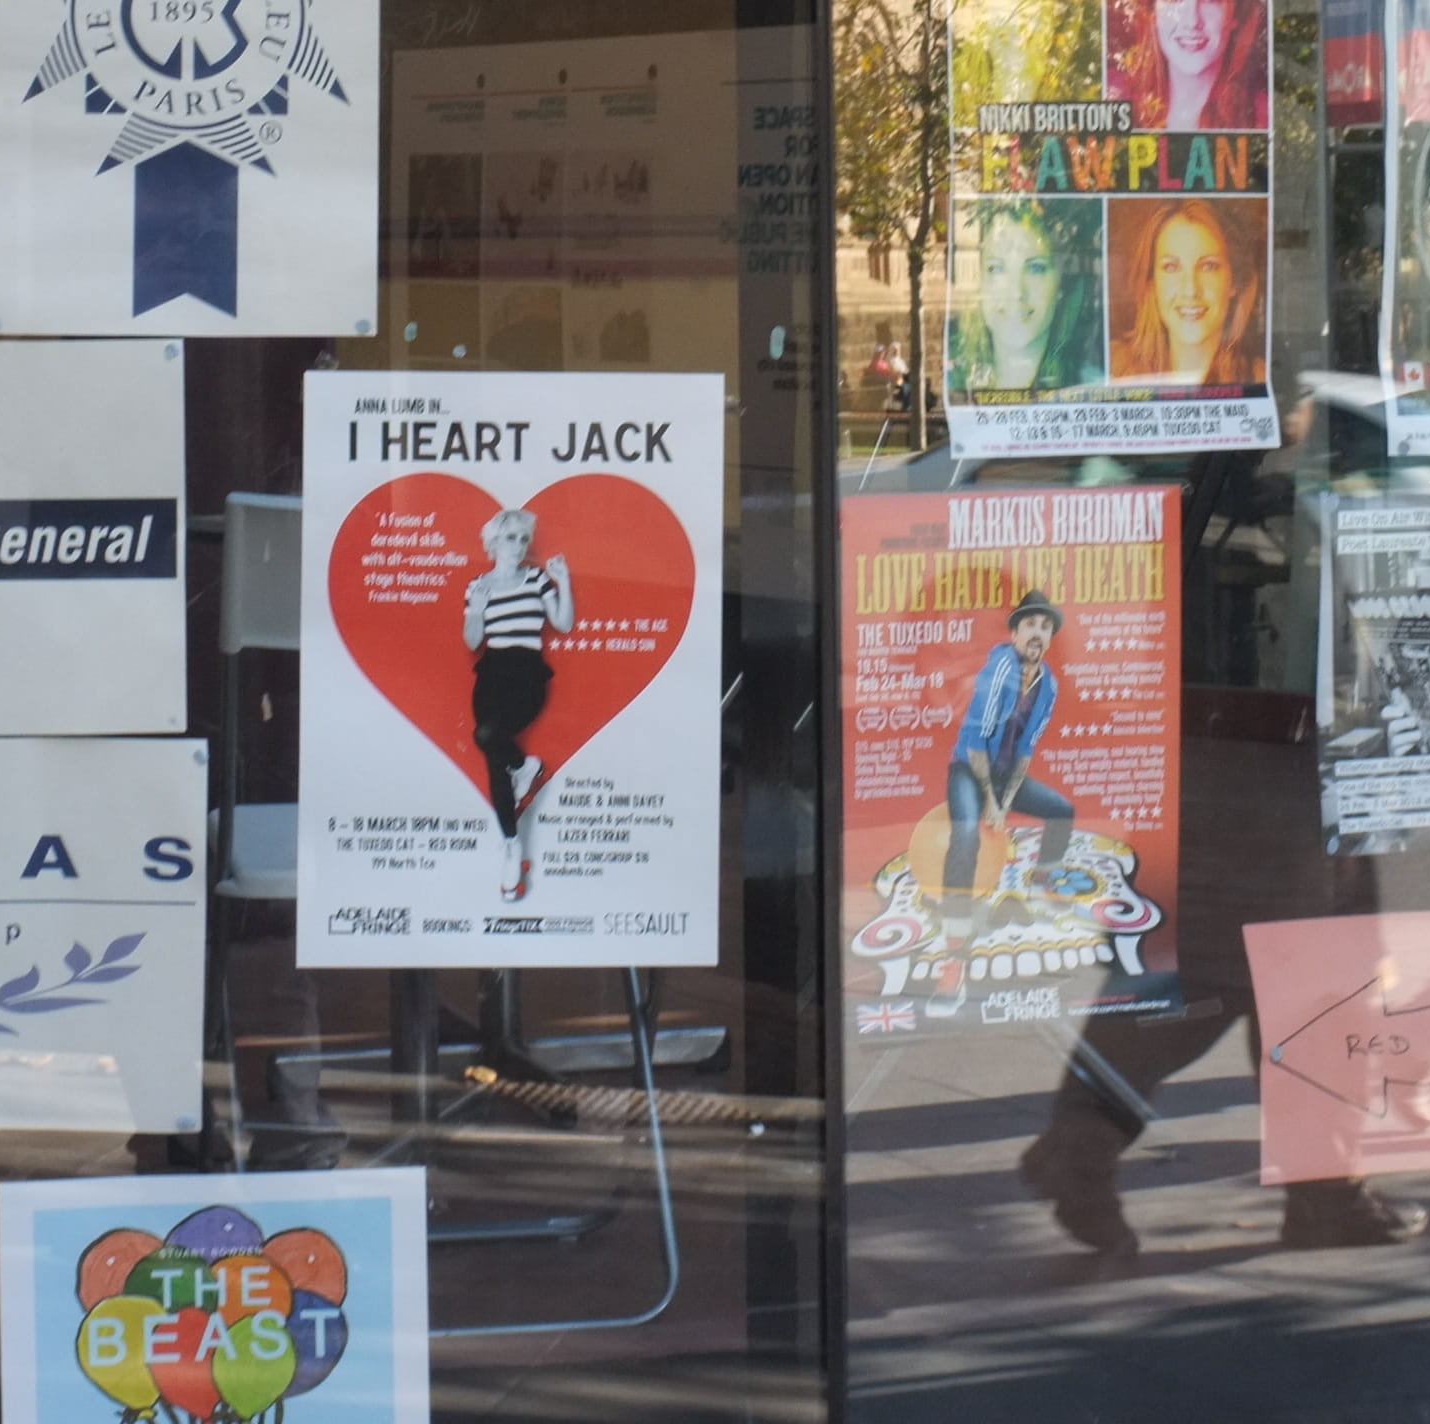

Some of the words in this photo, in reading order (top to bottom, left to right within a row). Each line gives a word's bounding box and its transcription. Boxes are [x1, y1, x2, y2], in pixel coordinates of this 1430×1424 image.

[148, 0, 216, 24] 1895
[86, 10, 117, 57] LE
[133, 78, 247, 118] PARIS
[980, 103, 1030, 132] NIKKI
[1034, 103, 1131, 131] BRITTON'S
[982, 135, 1117, 192] FLAW
[1128, 135, 1249, 192] PLAN
[349, 421, 358, 462] I
[381, 421, 531, 462] HEART
[551, 421, 674, 463] JACK
[948, 494, 1045, 550] MARKUS
[1052, 491, 1164, 545] BIRDMAN
[856, 552, 925, 614] LOVE
[933, 549, 1005, 611] HATE
[1011, 546, 1067, 608] LIFE
[1074, 542, 1165, 603] DEATH
[857, 623, 885, 648] THE
[889, 620, 943, 646] TUXEDO
[947, 619, 974, 644] CAT
[603, 912, 691, 937] SEESAULT
[987, 989, 1060, 1007] ADELAIDE
[1346, 1032, 1410, 1058] RED
[150, 1265, 272, 1309] THE
[87, 1308, 341, 1368] BEAST
